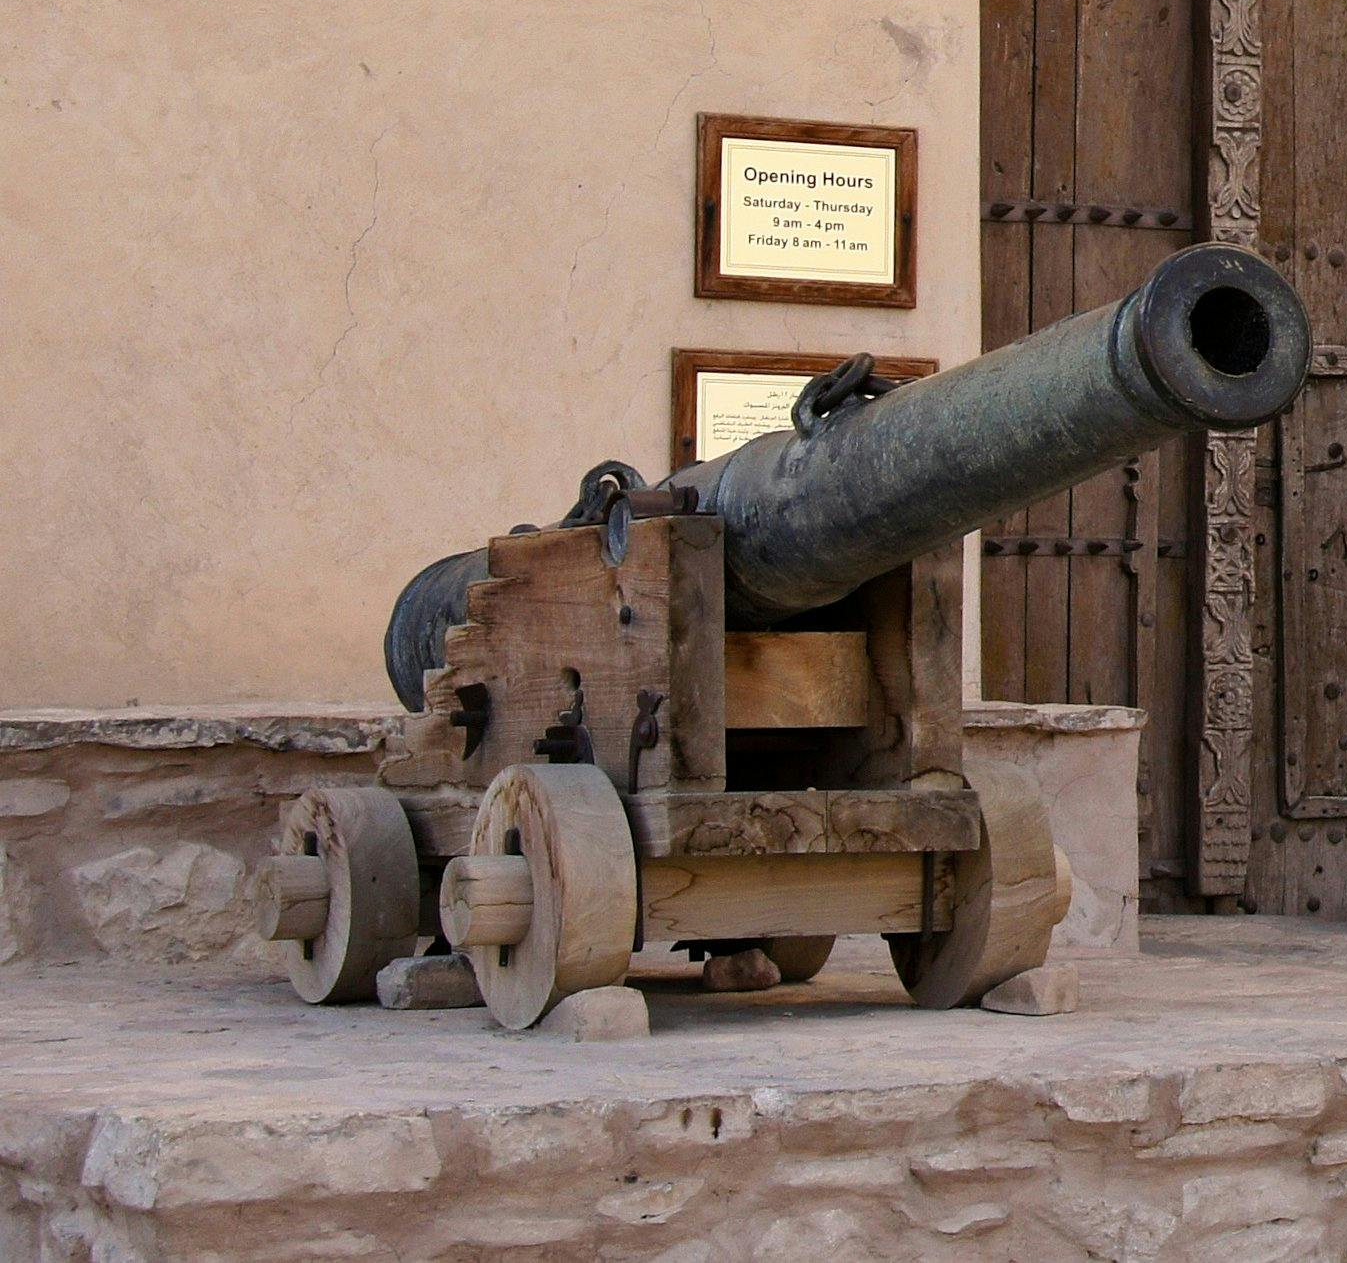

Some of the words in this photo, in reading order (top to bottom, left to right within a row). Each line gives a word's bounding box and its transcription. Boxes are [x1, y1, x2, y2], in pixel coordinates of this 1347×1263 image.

[744, 166, 817, 189] Opening
[823, 171, 873, 189] Hours
[743, 195, 801, 212] Saturday
[813, 200, 873, 217] Thursday
[772, 217, 780, 227] 9
[783, 220, 802, 228] am
[814, 220, 822, 229] 4
[825, 222, 845, 232] pm
[748, 234, 788, 249] Friday
[792, 236, 800, 246] 8
[802, 239, 822, 248] am
[834, 239, 847, 249] 11
[849, 242, 868, 251] am
